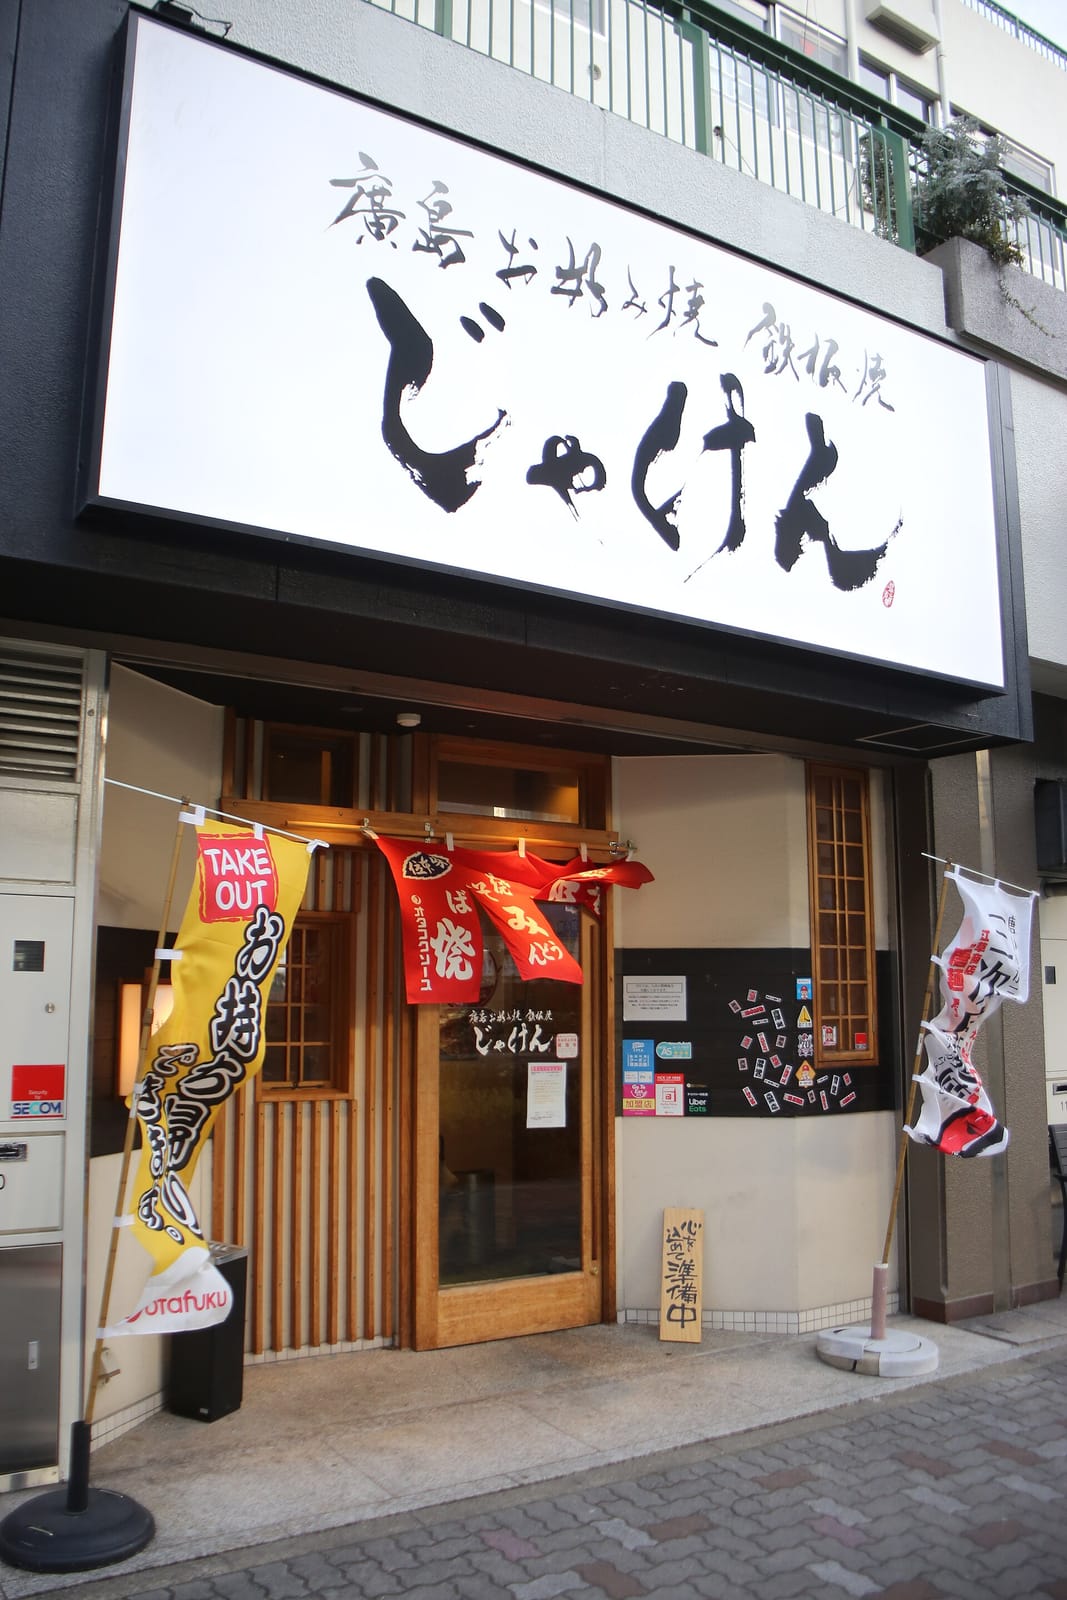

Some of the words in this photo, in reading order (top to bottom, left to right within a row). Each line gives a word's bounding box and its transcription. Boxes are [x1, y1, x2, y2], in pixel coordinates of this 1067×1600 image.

[366, 276, 904, 592] じゃけん
[204, 848, 272, 876] TAKE
[215, 880, 267, 910] OUT
[473, 1022, 554, 1056] じゃけん
[12, 1102, 62, 1114] SECOM
[664, 1258, 698, 1329] 準備中
